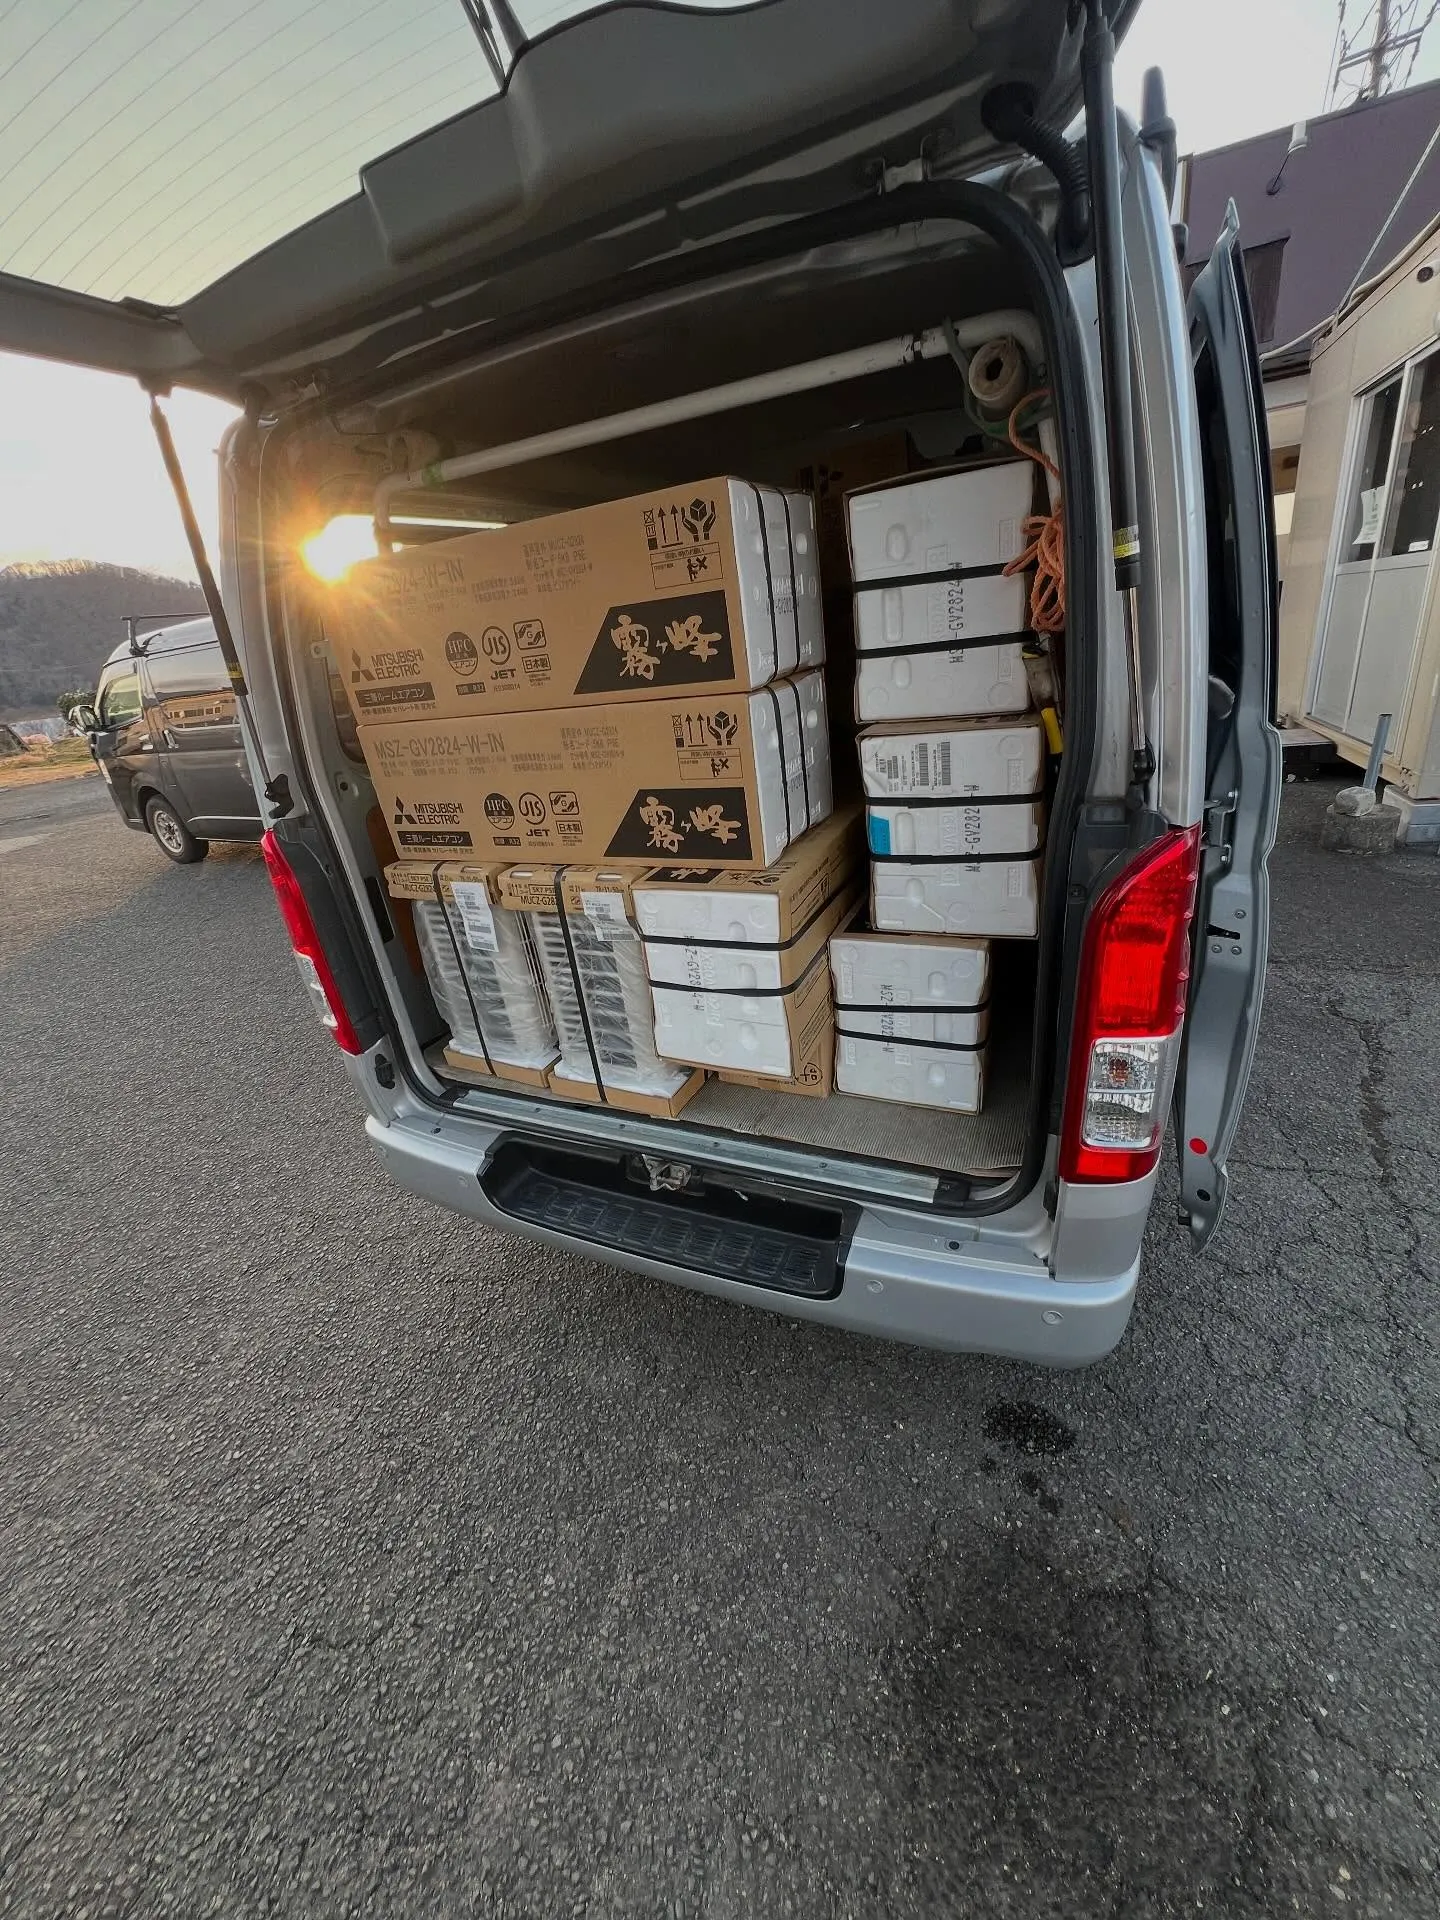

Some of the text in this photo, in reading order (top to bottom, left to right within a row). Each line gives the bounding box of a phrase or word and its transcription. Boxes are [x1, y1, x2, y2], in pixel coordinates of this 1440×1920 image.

[948, 562, 964, 664] MS-GV2824W
[447, 637, 474, 654] HFC
[486, 634, 507, 657] JIS
[371, 648, 424, 668] MITSUBISHI
[524, 656, 550, 671] 日本製
[374, 662, 421, 680] ELECTRIC
[490, 668, 517, 681] JET
[363, 688, 425, 705] 三菱ルームエアコン
[373, 732, 506, 760] MSZ-GV2824-W-IN
[413, 802, 464, 814] MITSUBISHI
[486, 799, 510, 811] HFC
[521, 800, 542, 817] JIS
[416, 814, 460, 825] ELECTRIC
[558, 823, 581, 833] 日本製
[526, 828, 551, 838] JET
[963, 784, 981, 873] MZ-GV282-W
[405, 834, 465, 845] 三菱ルームエアコン
[520, 896, 560, 906] MUCZ-G282
[880, 984, 895, 1053] MSZ-V282-W
